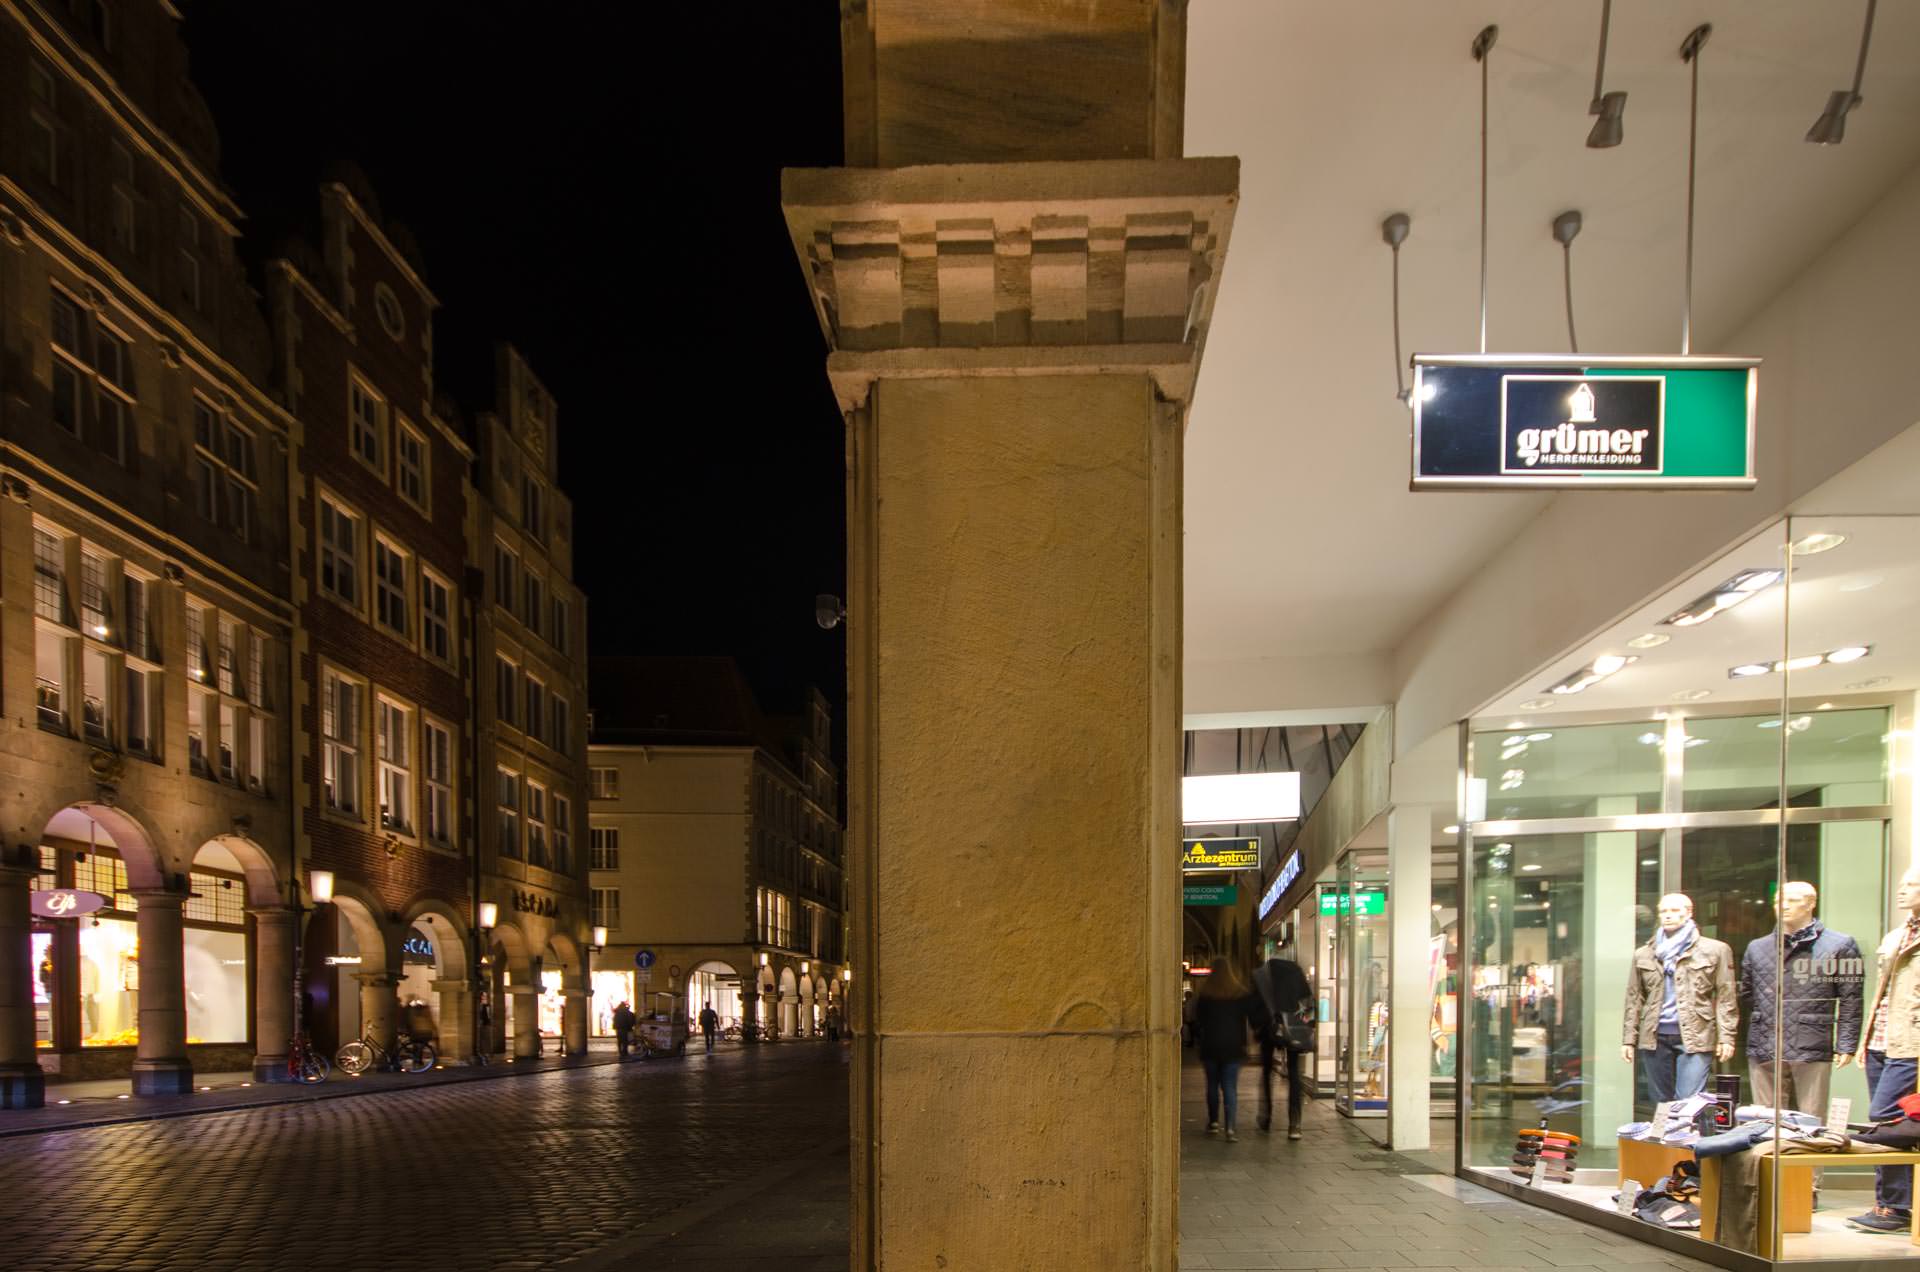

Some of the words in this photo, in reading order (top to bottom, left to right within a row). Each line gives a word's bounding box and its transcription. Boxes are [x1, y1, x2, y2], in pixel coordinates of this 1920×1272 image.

[1517, 423, 1649, 467] grümer
[1540, 454, 1642, 464] HERRENKLEIDUNG
[1183, 852, 1257, 864] Ärztezentrum
